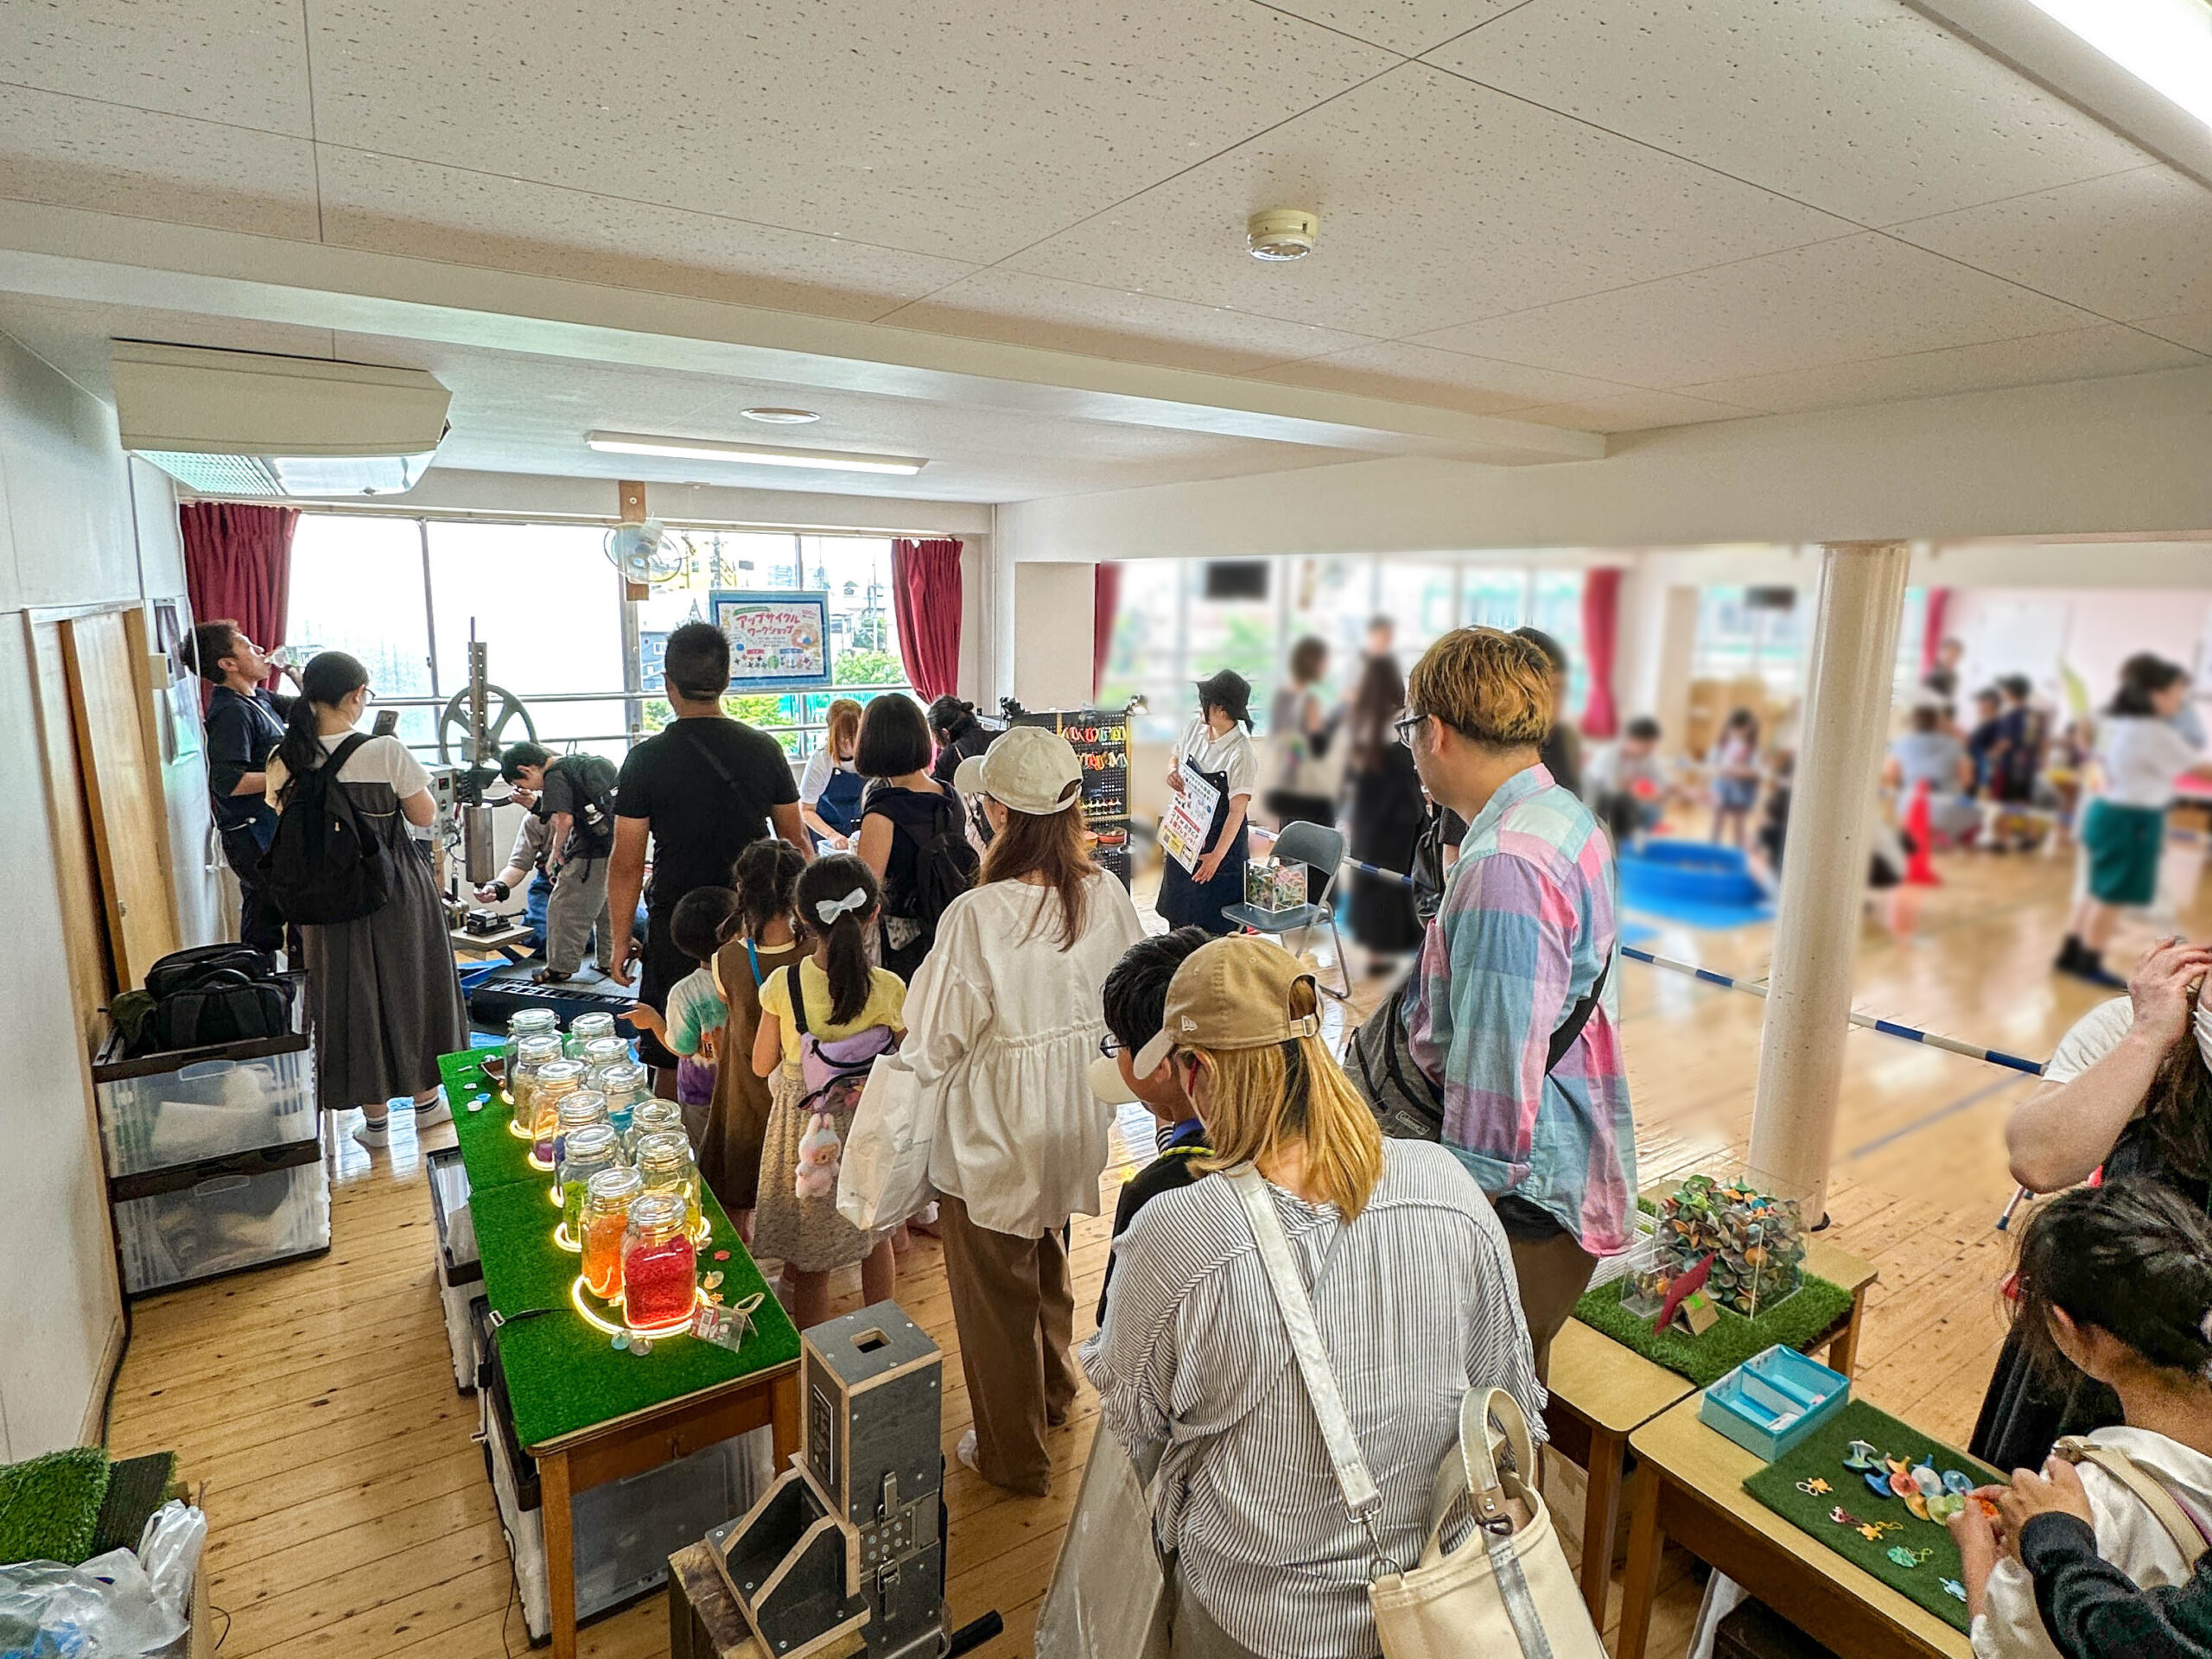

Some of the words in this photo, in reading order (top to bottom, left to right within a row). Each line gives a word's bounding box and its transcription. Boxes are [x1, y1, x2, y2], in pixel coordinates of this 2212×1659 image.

[736, 613, 800, 628] アップサイクル
[747, 626, 794, 636] ワークショップ
